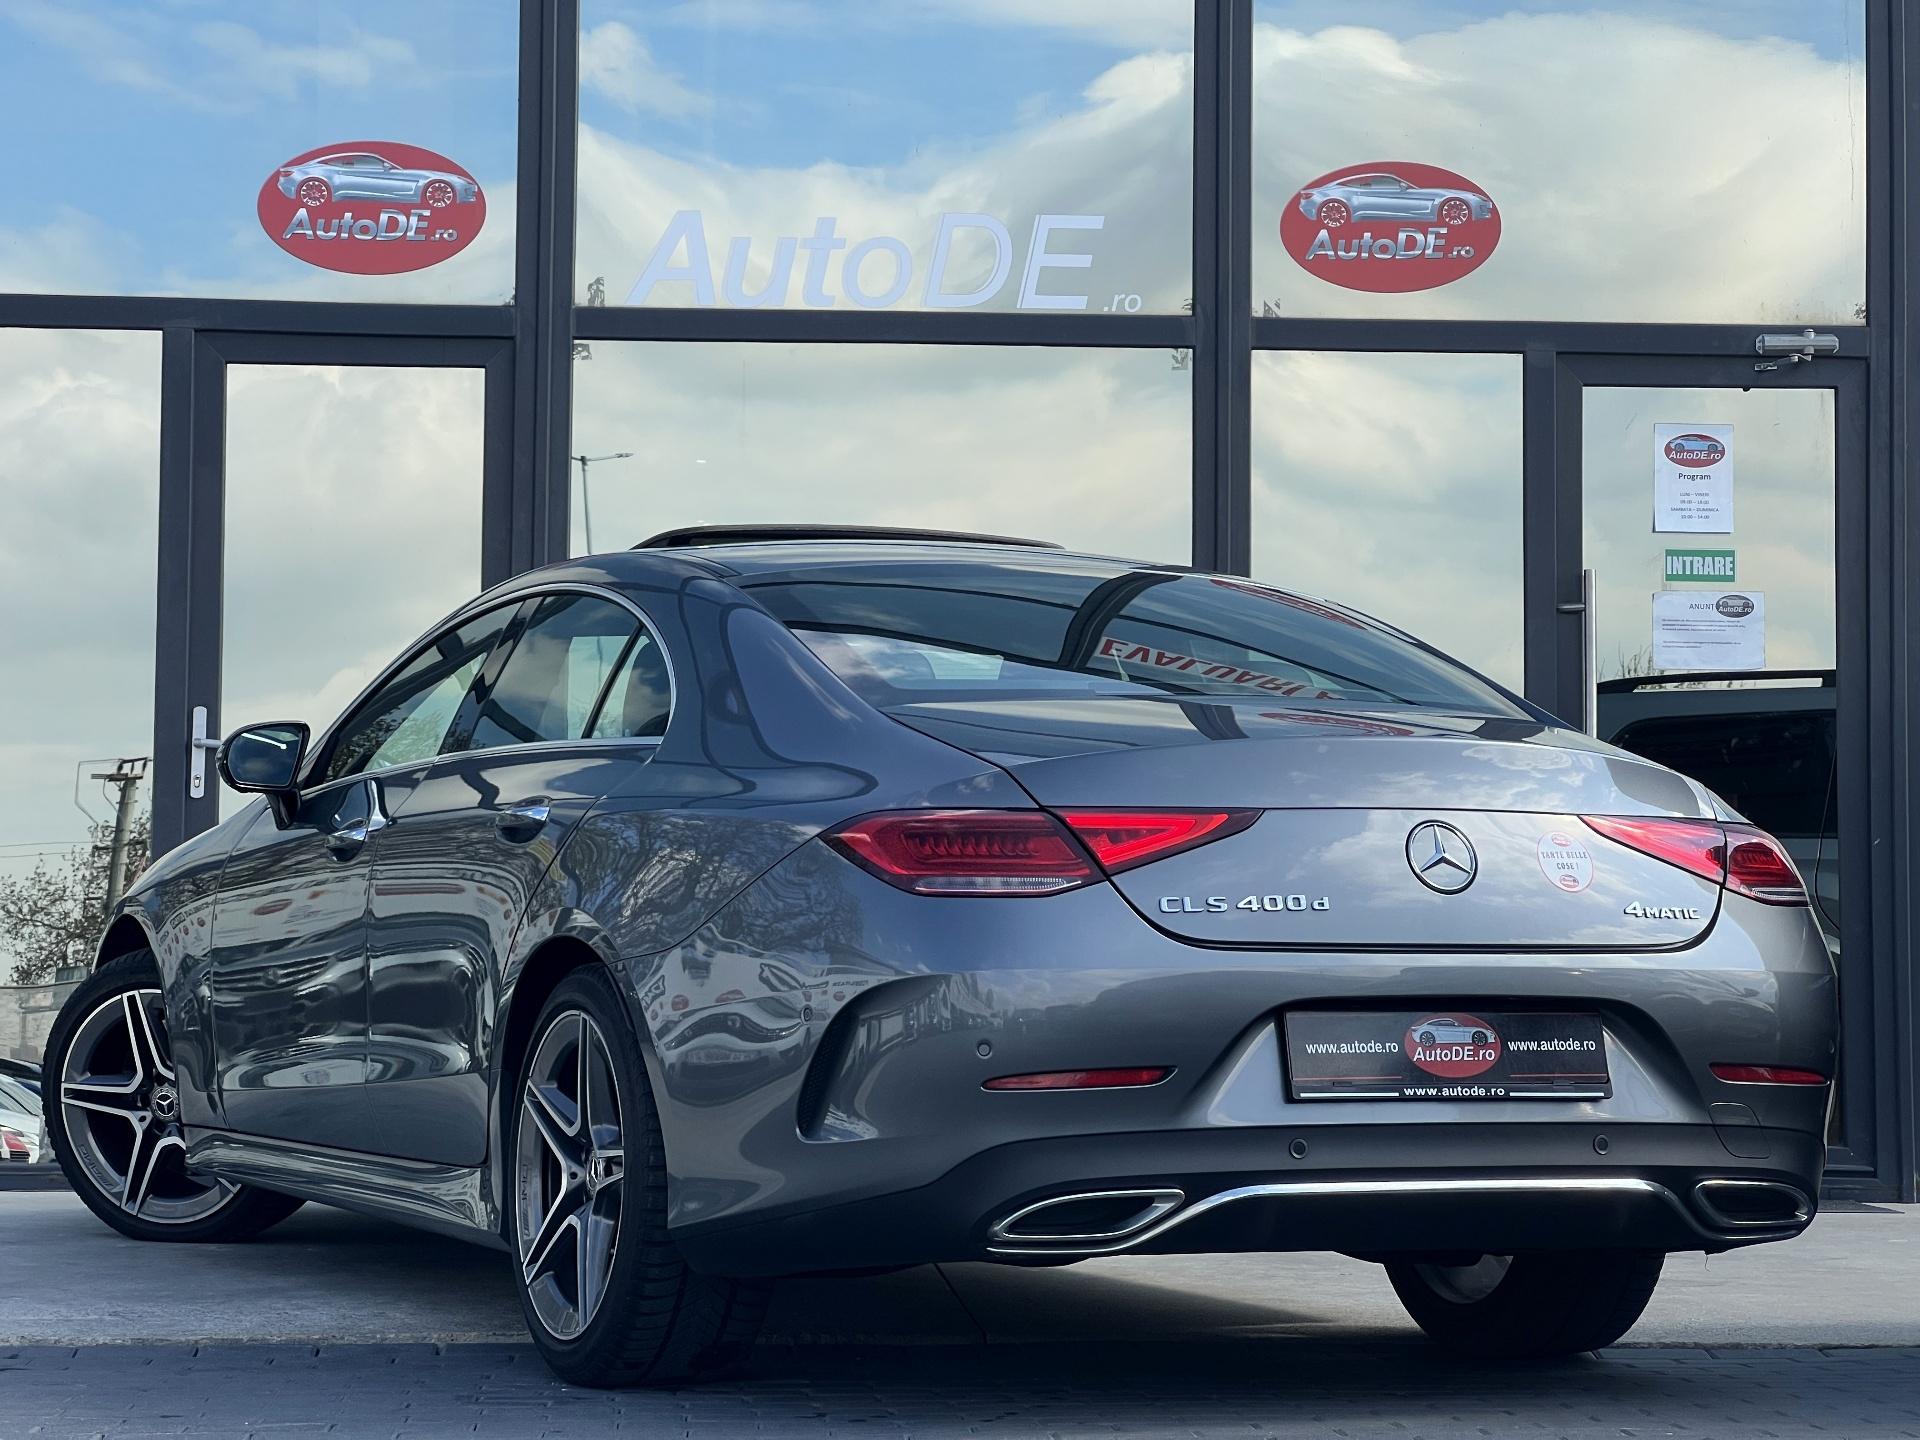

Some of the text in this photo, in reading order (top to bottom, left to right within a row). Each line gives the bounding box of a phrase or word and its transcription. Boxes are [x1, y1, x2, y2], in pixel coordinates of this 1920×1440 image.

[282, 207, 458, 241] AutoDE.ro
[1305, 227, 1475, 260] AutoDE.ro
[1669, 450, 1721, 460] AutoDE.ro
[1678, 473, 1711, 481] Program
[1666, 556, 1733, 575] INTRARE
[1159, 895, 1229, 913] CLS
[1624, 901, 1700, 919] 4MATIC
[1306, 1041, 1399, 1054] www.autode.ro
[1508, 1038, 1597, 1052] www.autode.ro
[1413, 1046, 1496, 1062] AutoDE.ro
[1404, 1085, 1506, 1097] www.autode.ro
